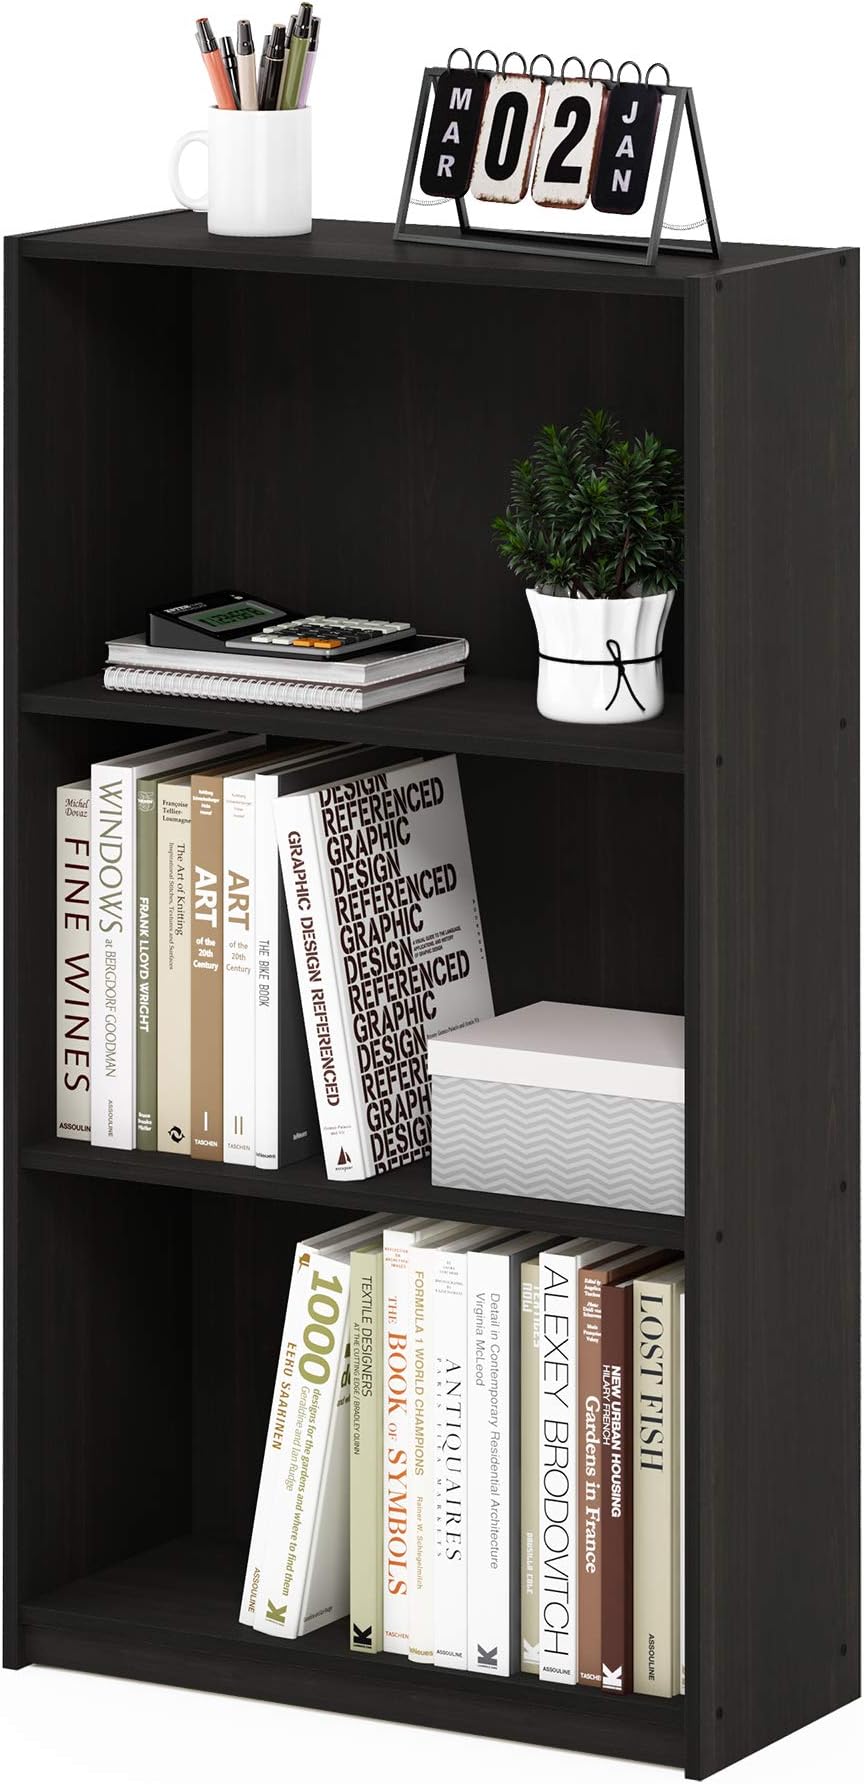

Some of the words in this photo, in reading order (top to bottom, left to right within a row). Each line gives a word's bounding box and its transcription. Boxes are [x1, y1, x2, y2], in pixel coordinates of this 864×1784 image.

[436, 87, 472, 178] MAR
[484, 91, 592, 184] 02
[611, 101, 638, 193] JAN
[65, 798, 90, 808] Michel
[65, 807, 88, 817] Dovaz
[318, 773, 388, 808] DESIGN
[321, 776, 445, 837] REFERENCED
[99, 780, 123, 933] WINDOWS
[177, 843, 185, 862] The
[326, 815, 411, 866] GRAPHIC
[64, 837, 90, 932] FINE
[177, 864, 185, 880] Art
[177, 883, 185, 893] of
[330, 849, 402, 897] DESIGN
[175, 896, 185, 935] Knitting
[195, 865, 217, 928] ART
[228, 869, 250, 931] ART
[334, 863, 457, 926] REFERENCED
[139, 896, 150, 938] FRANK
[340, 903, 424, 955] GRAPHIC
[105, 939, 112, 948] at
[139, 942, 150, 980] LLOYD
[196, 937, 203, 945] of
[203, 938, 216, 947] the
[198, 949, 214, 958] 20th
[231, 952, 246, 961] 20th
[237, 941, 248, 950] the
[259, 940, 270, 956] THE
[343, 937, 415, 985] DESIGN
[105, 951, 116, 1012] BERGDORF
[192, 960, 219, 971] Century
[226, 963, 251, 975] Century
[259, 960, 270, 980] BIKE
[288, 831, 311, 911] GRAPHIC
[300, 916, 322, 983] DESIGN
[311, 988, 340, 1107] REFERENCED
[347, 950, 470, 1015] REFERENCED
[139, 983, 150, 1032] WRIGHT
[259, 984, 270, 1007] BOOK
[353, 990, 437, 1044] GRAPHIC
[64, 953, 90, 1092] WINES
[105, 1014, 116, 1078] GOODMAN
[356, 1024, 428, 1074] DESIGN
[360, 1053, 432, 1104] REFERE
[59, 1122, 91, 1132] ASSOULIN
[366, 1081, 432, 1132] GRAPH
[194, 1138, 218, 1147] TASCHEN
[227, 1143, 250, 1151] TASCHEN
[361, 1275, 373, 1323] TEXTILE
[388, 1296, 397, 1324] THE
[414, 1270, 425, 1333] FORMULA
[473, 1293, 485, 1336] Virginia
[490, 1293, 500, 1328] Detail
[298, 1270, 343, 1385] 1000
[354, 1322, 360, 1333] AT
[490, 1331, 500, 1340] in
[544, 1265, 569, 1408] ALEXEY
[640, 1294, 664, 1385] LOST
[361, 1327, 373, 1398] DESIGNERS
[387, 1331, 408, 1415] BOOK
[414, 1350, 425, 1395] WORLD
[475, 1337, 485, 1386] McLeod
[602, 1364, 610, 1402] HILARY
[611, 1365, 621, 1398] NEW
[295, 1385, 310, 1429] Geraldine
[308, 1388, 322, 1423] designs
[488, 1344, 500, 1429] Contemporary
[272, 1381, 292, 1451] SAARINEN
[306, 1424, 317, 1439] for
[388, 1422, 397, 1441] OF
[414, 1398, 425, 1477] CHAMPIONS
[585, 1395, 600, 1477] Gardens
[602, 1403, 610, 1446] FRENCH
[611, 1400, 621, 1450] URBAN
[640, 1394, 664, 1473] FISH
[290, 1447, 301, 1462] Ian
[293, 1430, 303, 1447] and
[303, 1440, 314, 1455] the
[442, 1358, 462, 1561] ANTIQUAIRES
[285, 1463, 298, 1492] Rudge
[298, 1455, 310, 1493] gardens
[489, 1431, 500, 1496] Residential
[611, 1453, 621, 1518] HOUSING
[295, 1493, 305, 1511] and
[585, 1481, 600, 1500] in
[290, 1512, 302, 1541] where
[387, 1448, 408, 1596] SYMBOLS
[489, 1499, 500, 1571] Architecture
[543, 1419, 570, 1656] BRODOVITCH
[585, 1506, 600, 1574] France
[286, 1553, 298, 1572] find
[289, 1542, 298, 1552] to
[415, 1535, 424, 1590] Schlegelmilch
[247, 1567, 261, 1613] ASSOULINE
[281, 1573, 293, 1597] them
[385, 1630, 409, 1639] TASCHEN
[436, 1649, 463, 1657] ASSOULINE
[542, 1666, 571, 1675] ASSOULINE
[580, 1672, 601, 1681] TASCHE
[648, 1633, 656, 1681] ASSOULINE
